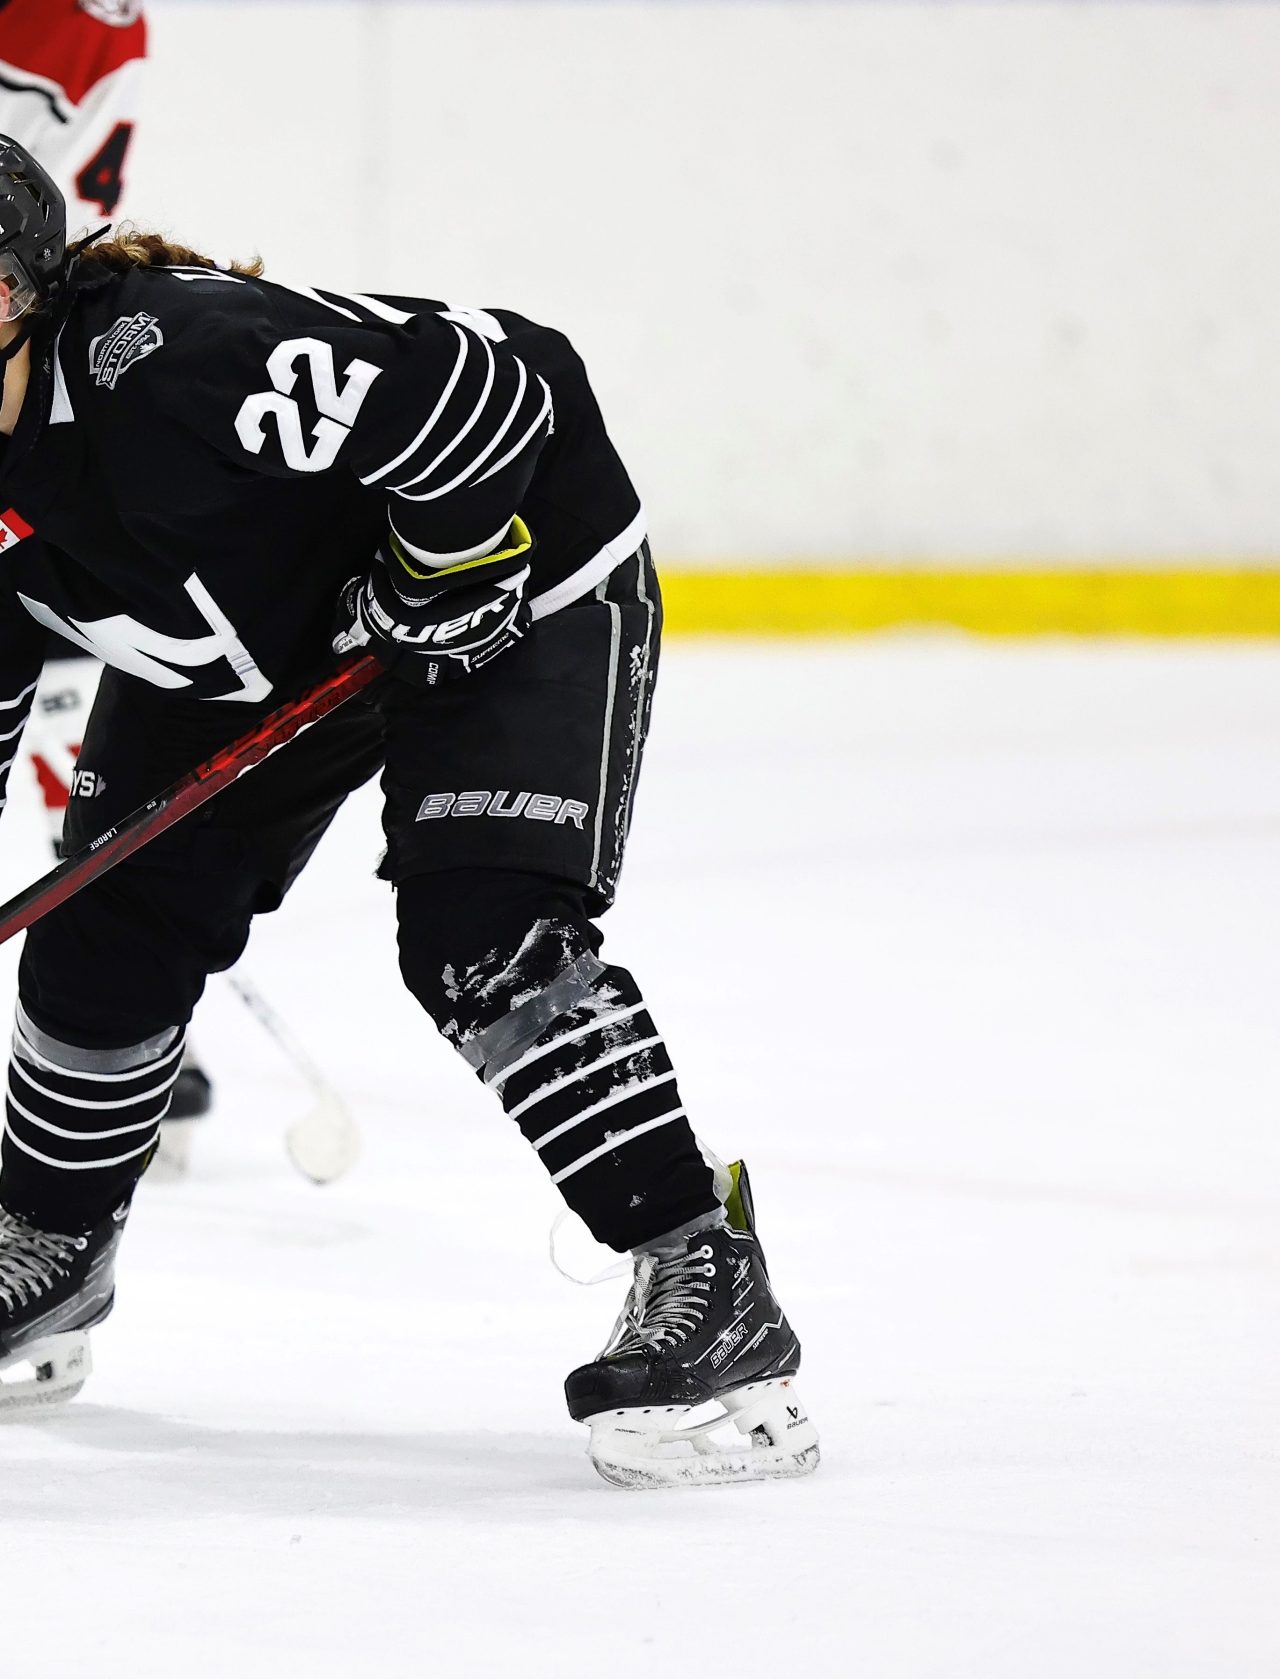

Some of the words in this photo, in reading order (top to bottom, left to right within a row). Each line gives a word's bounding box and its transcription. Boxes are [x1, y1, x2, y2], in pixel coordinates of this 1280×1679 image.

[76, 121, 134, 216] 4
[95, 339, 112, 367] NORTH
[109, 321, 128, 339] YORK
[101, 316, 151, 382] STORM
[234, 336, 384, 473] 22
[426, 662, 439, 685] COMP
[415, 790, 589, 830] BAUER
[89, 827, 118, 851] LAROSE
[709, 1322, 748, 1369] BAUER
[786, 1416, 809, 1430] BAUER
